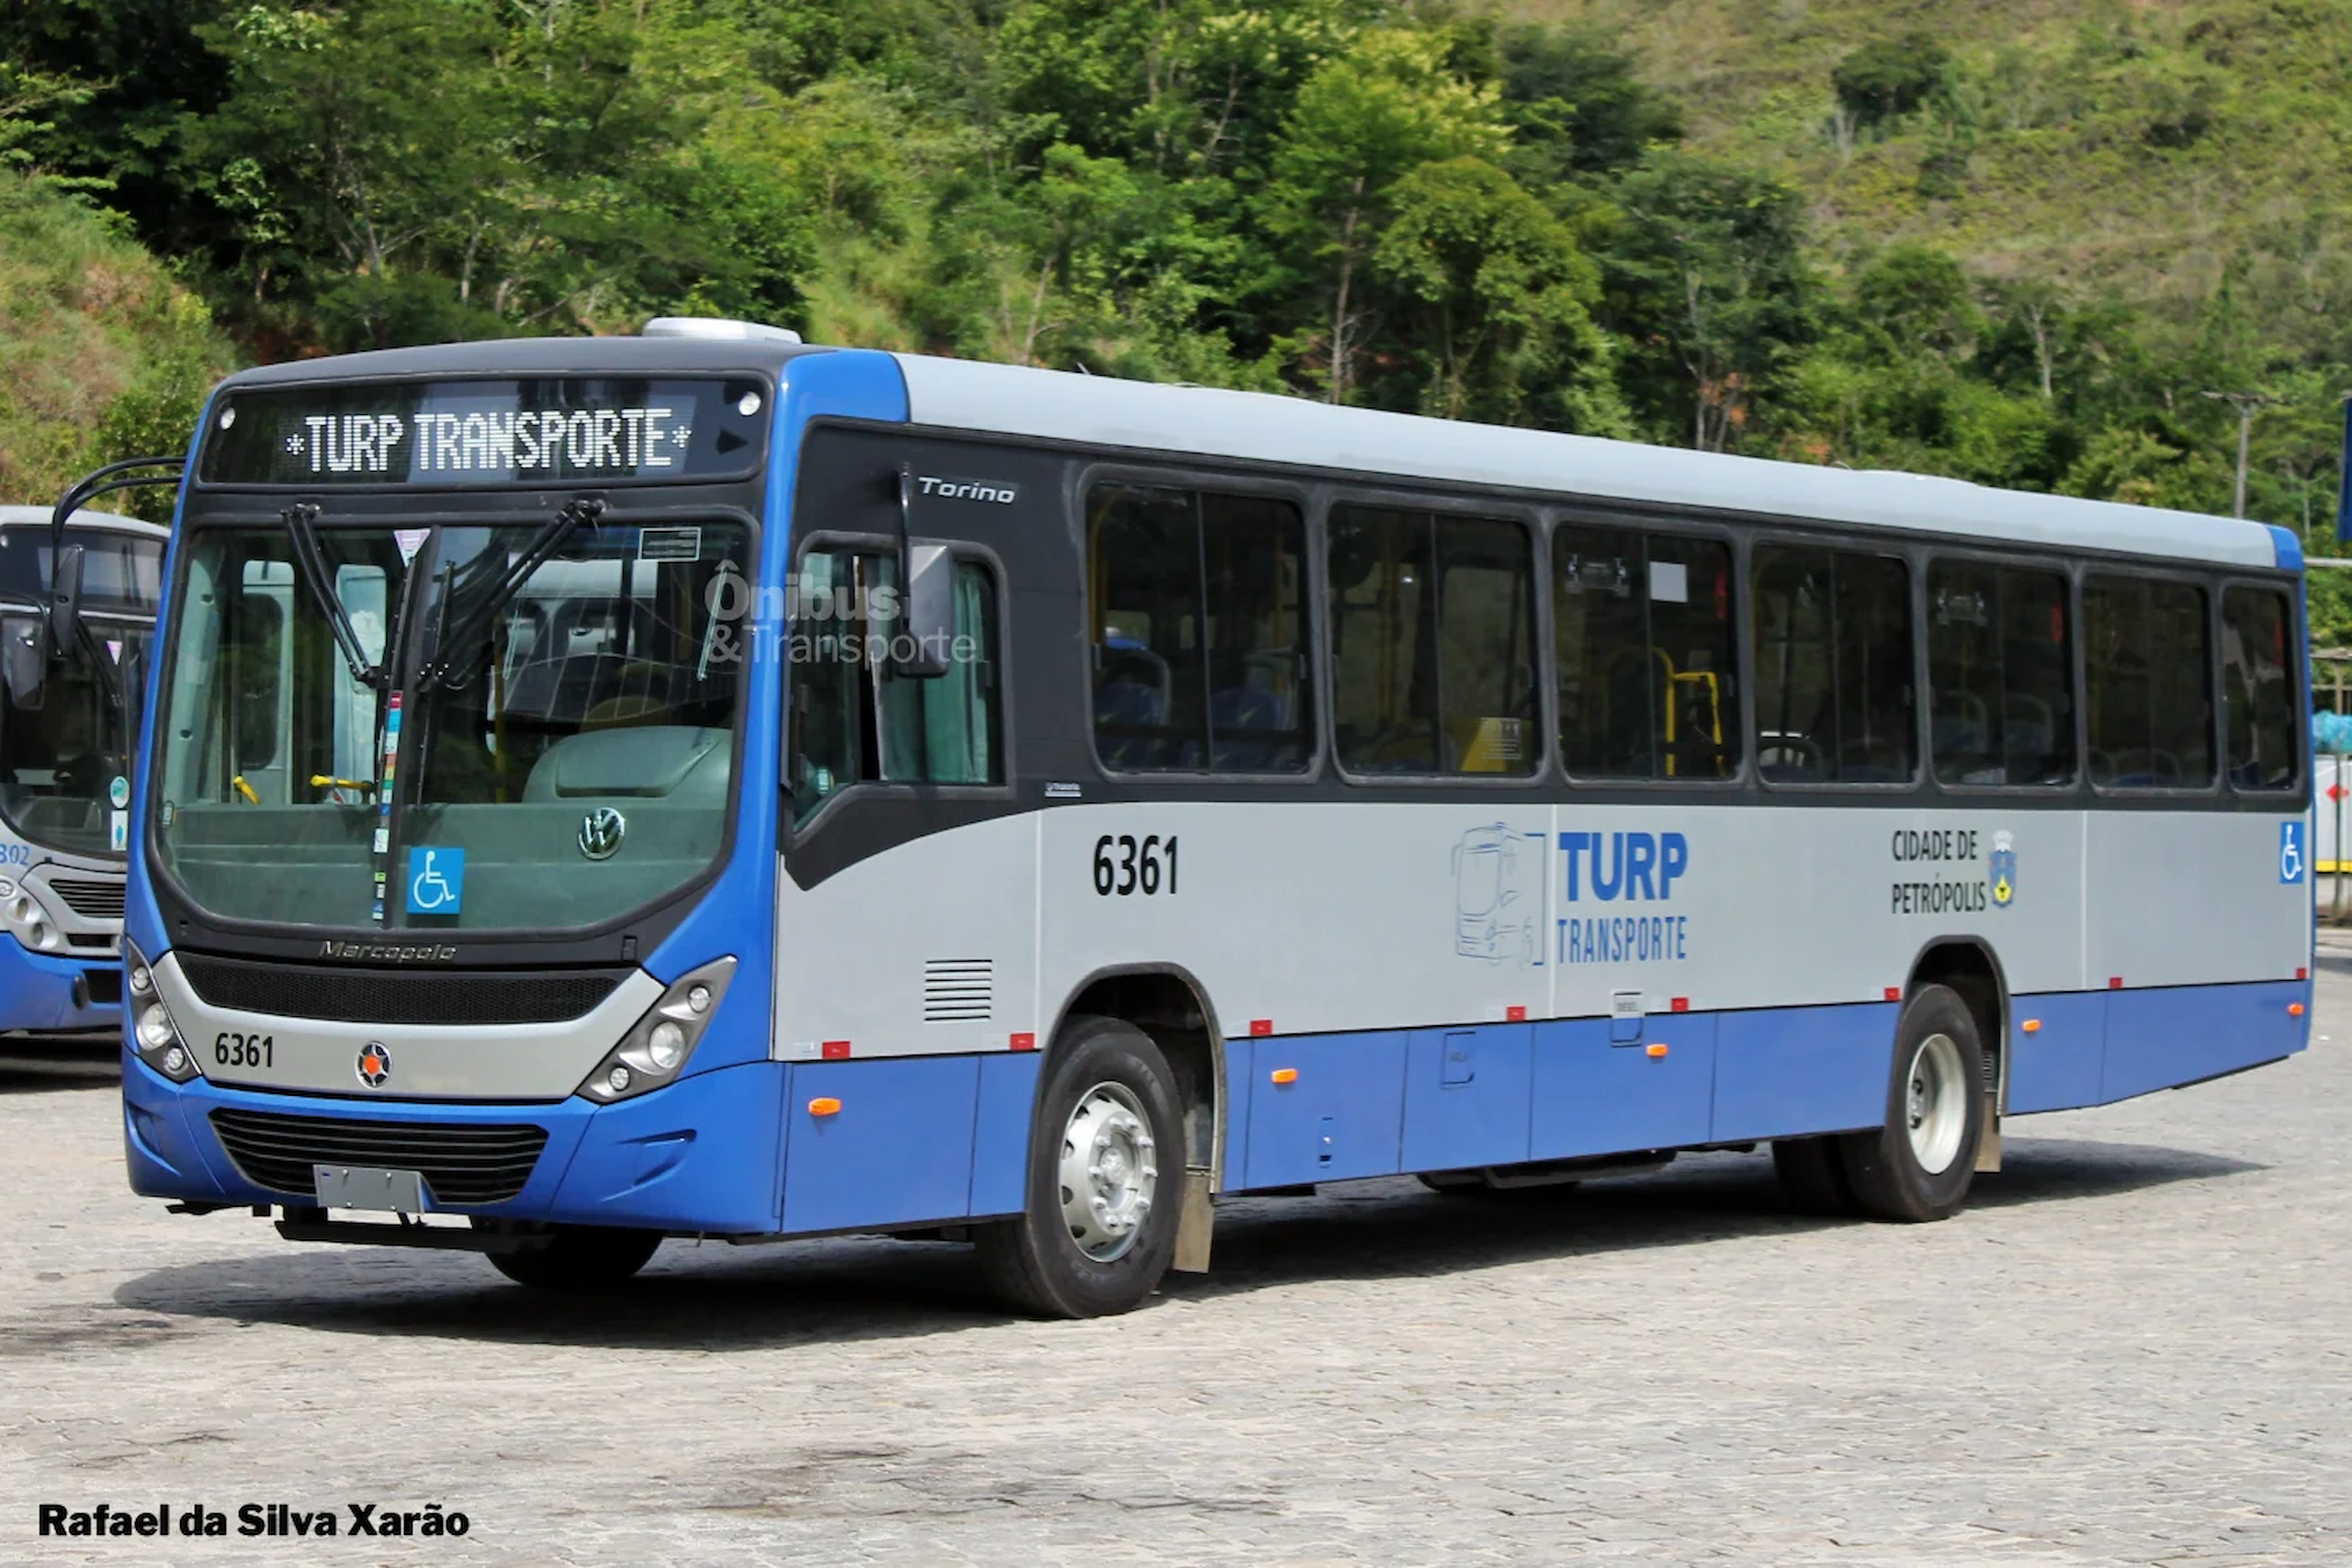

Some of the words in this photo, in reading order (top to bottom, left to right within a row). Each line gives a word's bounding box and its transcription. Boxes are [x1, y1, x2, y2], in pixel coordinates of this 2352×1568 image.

[305, 414, 403, 473] TURP
[413, 408, 672, 470] TRANSPORTE
[919, 477, 1015, 504] Torino
[1093, 834, 1178, 896] 6361
[1559, 832, 1689, 901] TURP
[1893, 830, 1952, 861] CIDADE
[1957, 830, 1978, 860] DE
[1892, 872, 1986, 914] PETRÓPOLIS
[319, 941, 457, 964] Marcopolo
[1558, 917, 1687, 963] TRANSPORTE
[215, 1032, 273, 1067] 6361
